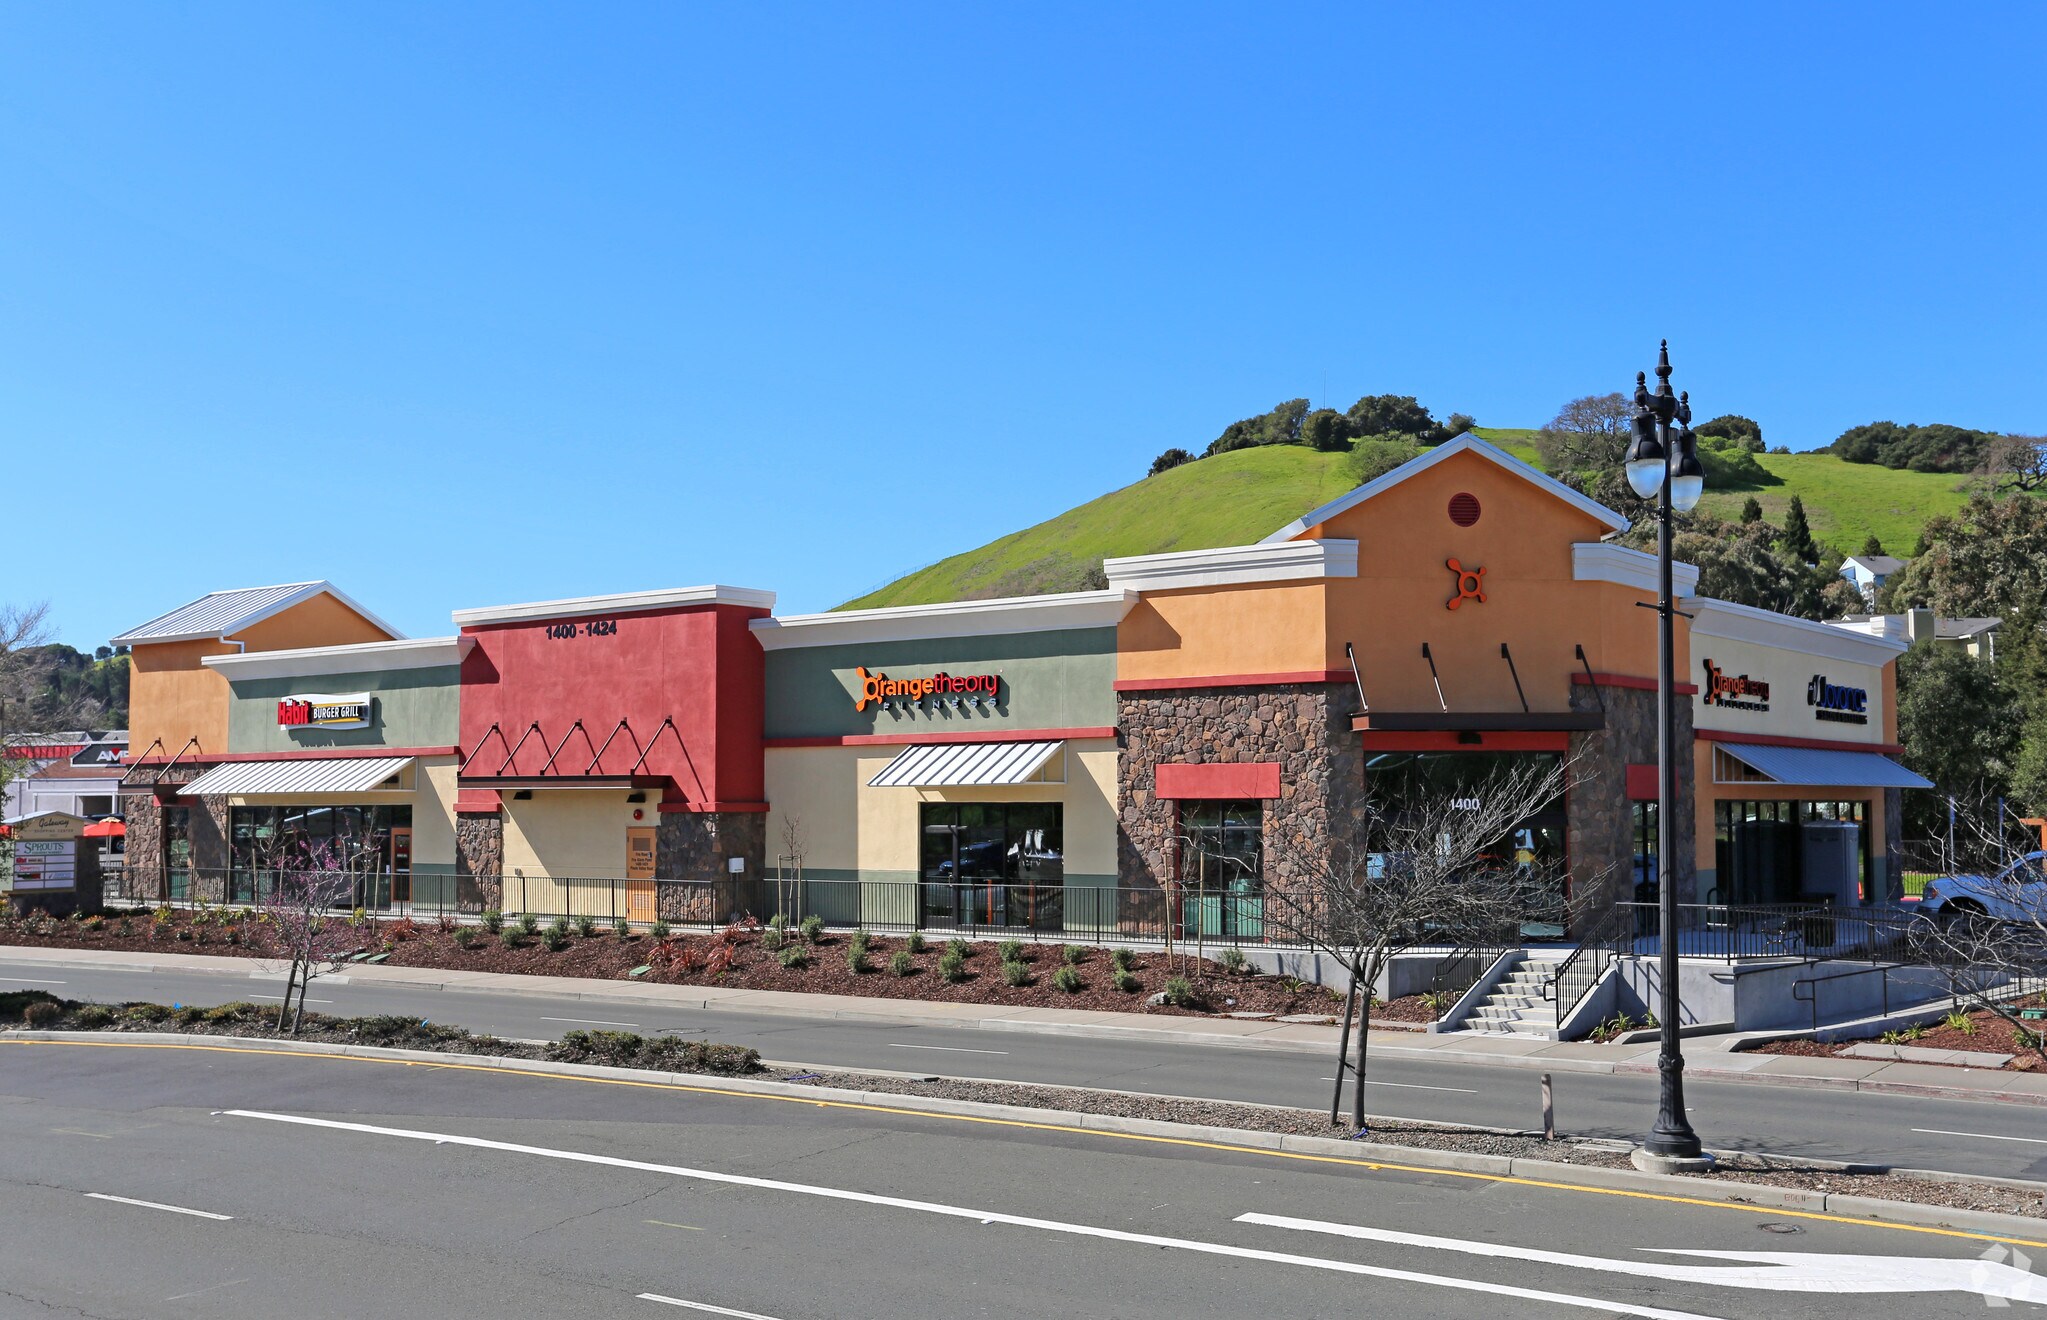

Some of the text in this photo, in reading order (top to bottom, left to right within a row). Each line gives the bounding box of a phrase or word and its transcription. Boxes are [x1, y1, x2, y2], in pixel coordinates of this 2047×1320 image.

[855, 666, 998, 712] Orangetheory
[883, 699, 997, 711] FITNESS
[278, 700, 309, 725] Habit
[313, 704, 359, 719] BURGER GRILL
[1450, 798, 1480, 810] 1400
[38, 818, 69, 828] Gateway
[24, 842, 64, 854] SPROUTS
